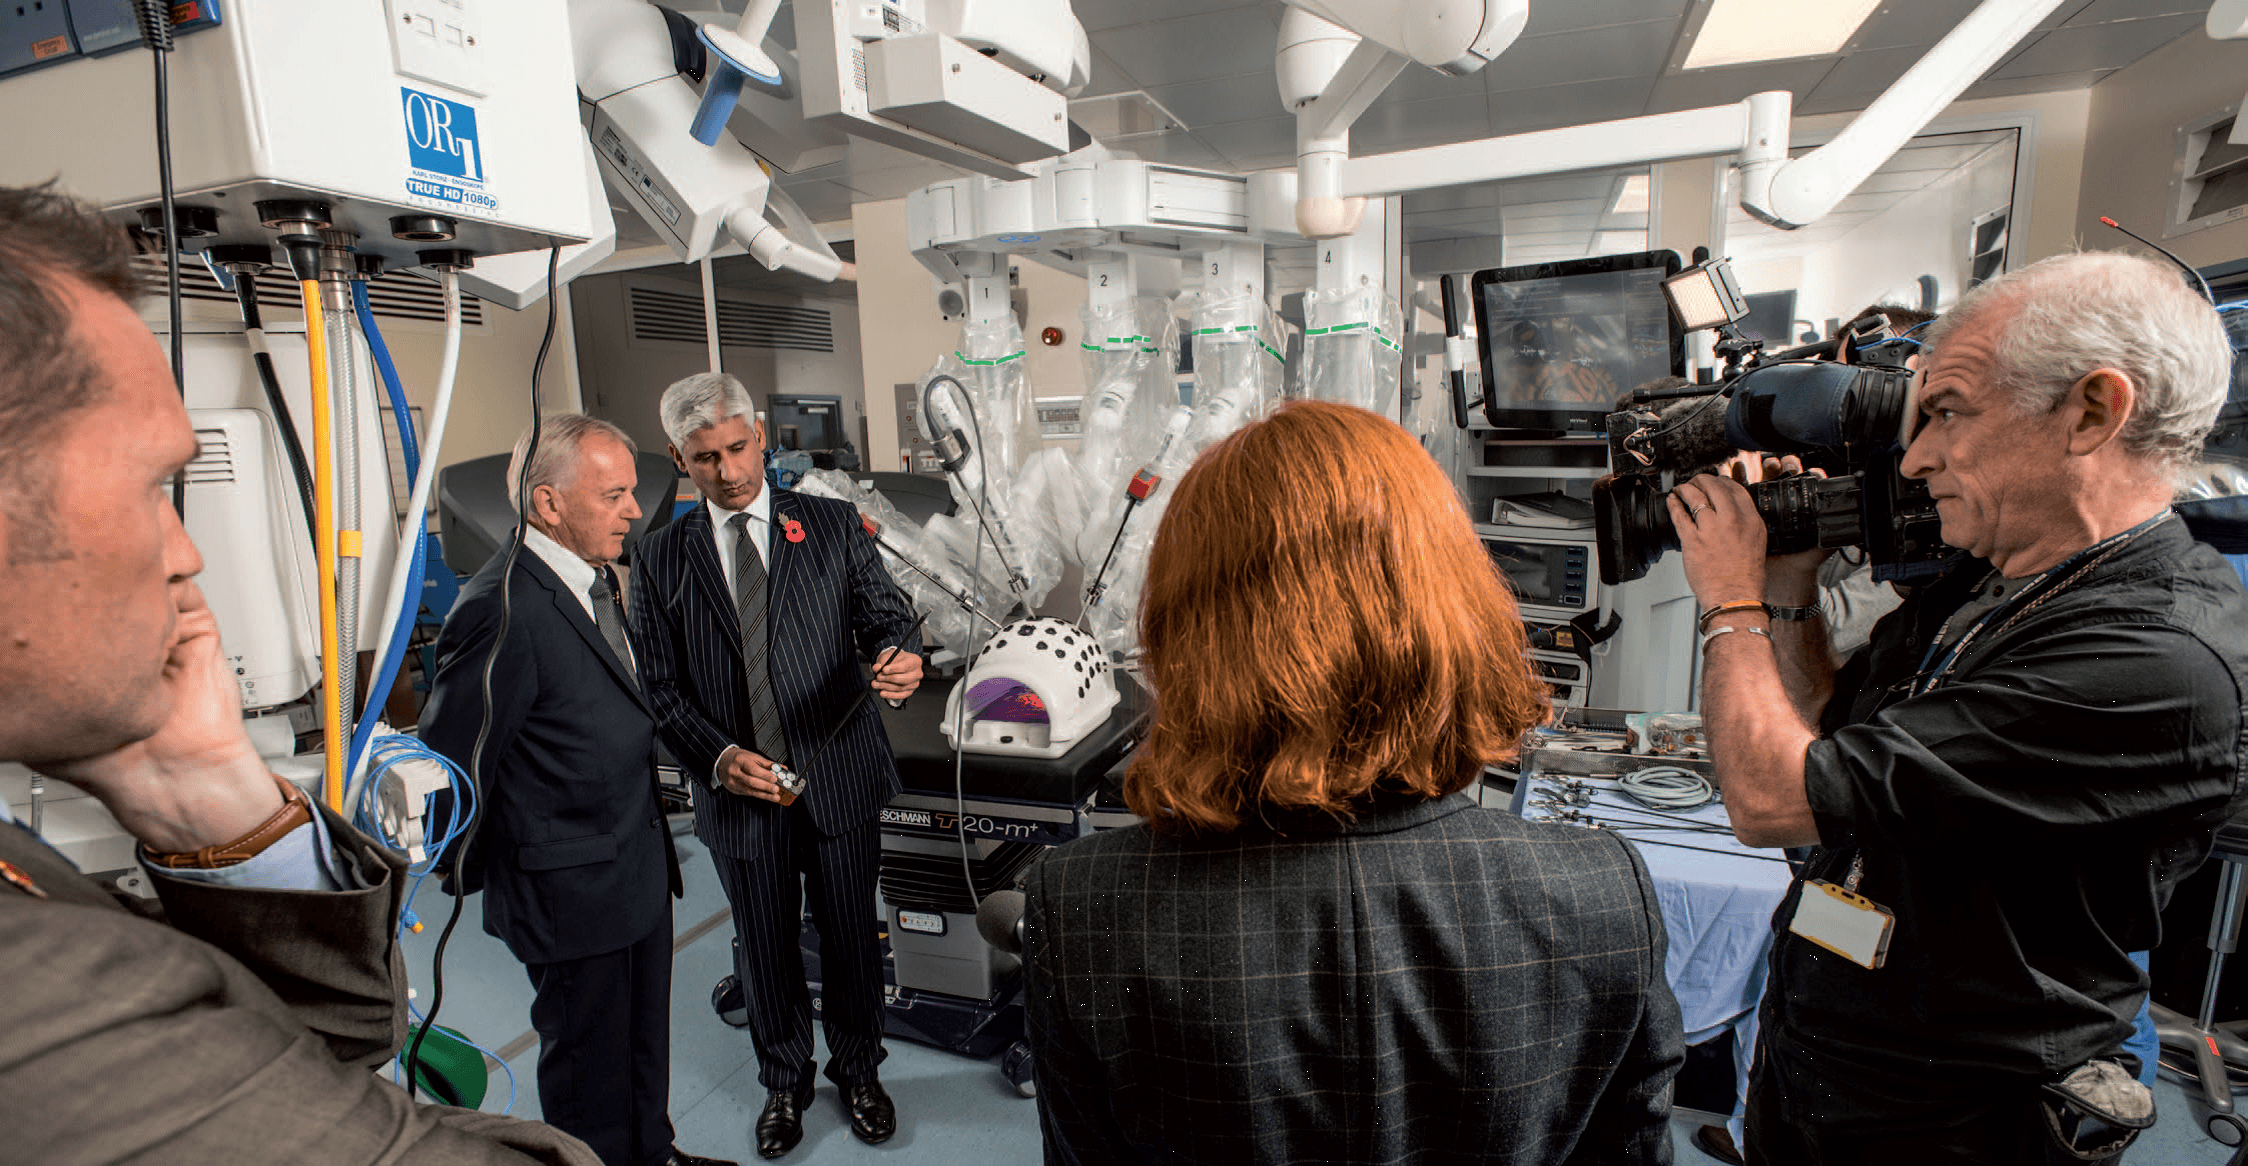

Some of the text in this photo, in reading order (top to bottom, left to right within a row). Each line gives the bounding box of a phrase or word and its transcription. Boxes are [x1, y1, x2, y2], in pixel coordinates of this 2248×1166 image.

[408, 181, 497, 209] TRUE HD 1080p
[1325, 250, 1331, 264] 4
[1211, 262, 1219, 276] 3
[1100, 274, 1108, 287] 2
